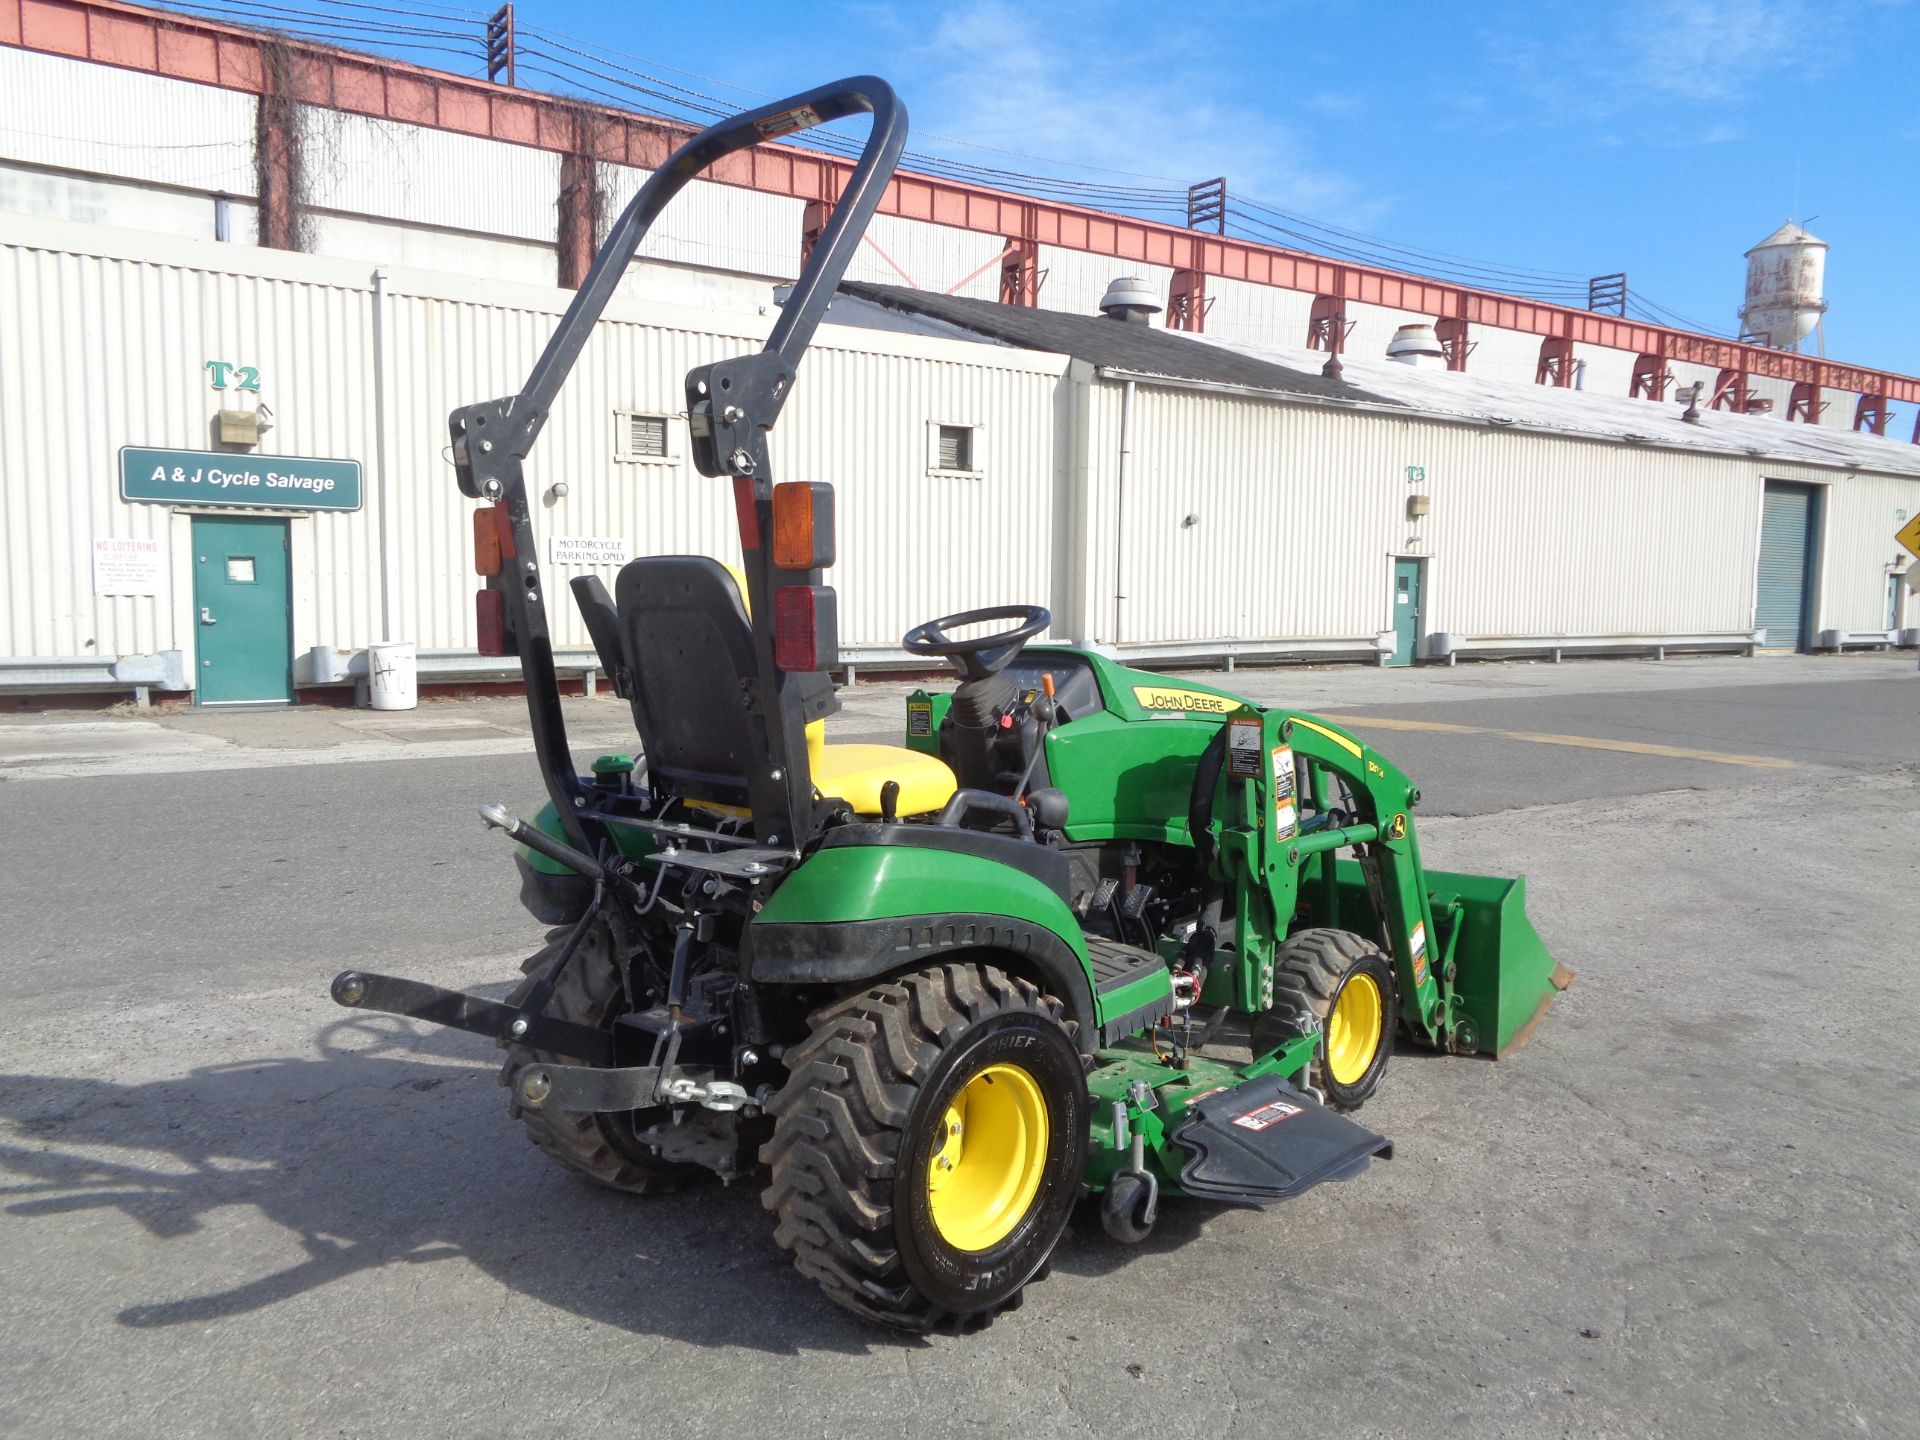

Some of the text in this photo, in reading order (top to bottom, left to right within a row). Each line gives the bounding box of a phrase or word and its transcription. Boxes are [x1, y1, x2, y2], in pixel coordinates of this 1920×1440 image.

[205, 360, 260, 391] T2
[151, 466, 335, 492] A & J Cycle Salvage
[96, 541, 158, 553] NO LOITERING
[559, 540, 623, 550] MOTORCYCLE
[556, 551, 625, 561] PARKING ONLY
[1149, 693, 1224, 712] JOHN DEERE
